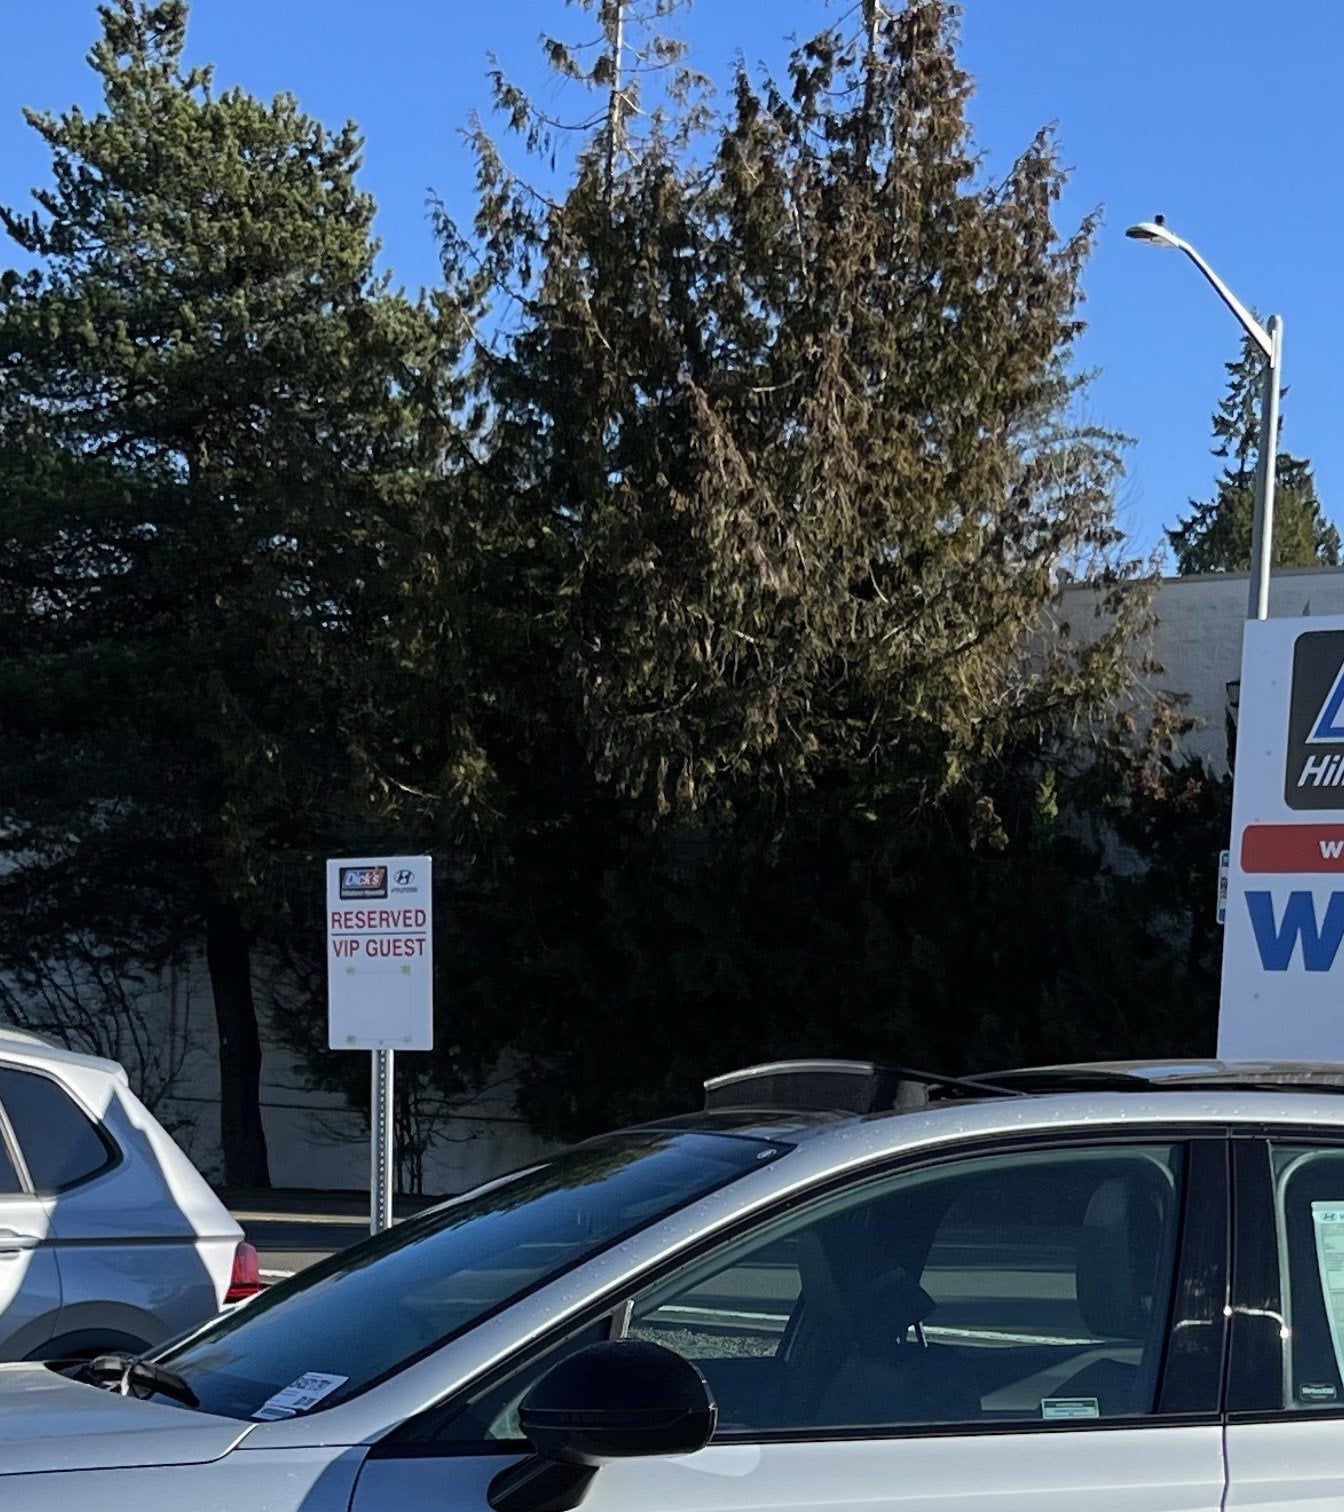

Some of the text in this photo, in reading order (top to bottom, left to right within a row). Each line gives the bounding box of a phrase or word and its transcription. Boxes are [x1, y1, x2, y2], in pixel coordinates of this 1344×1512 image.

[331, 909, 427, 929] RESERVED
[332, 938, 426, 957] VIP GUEST
